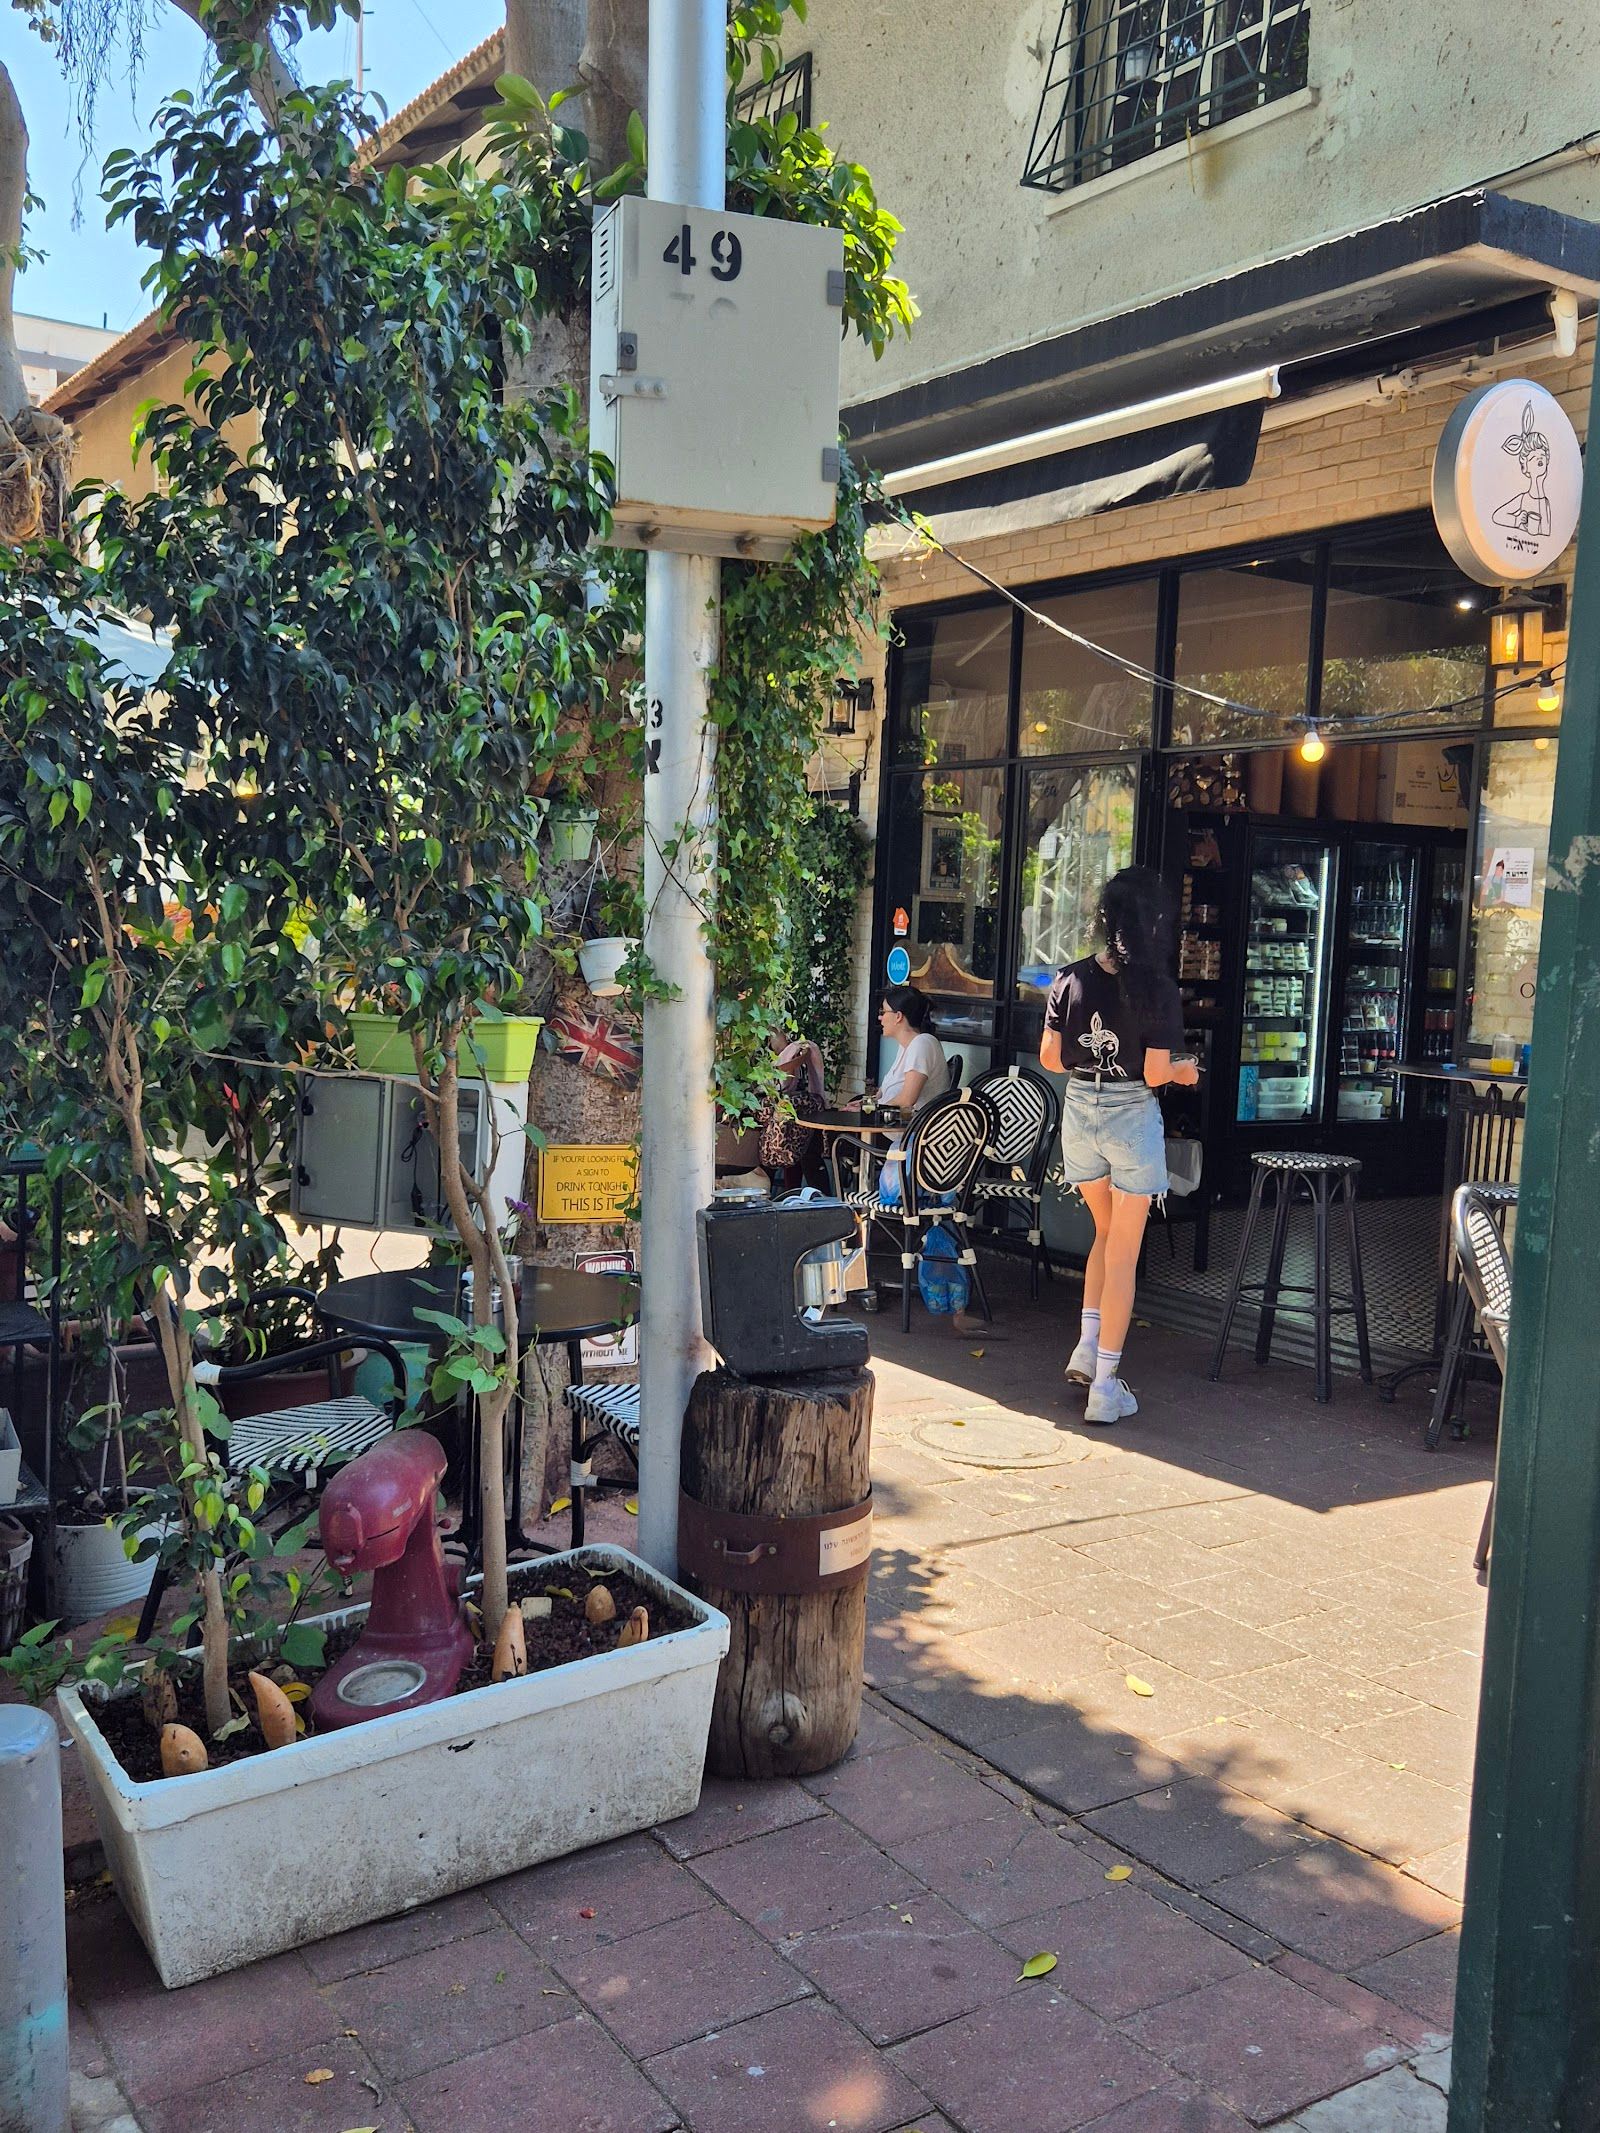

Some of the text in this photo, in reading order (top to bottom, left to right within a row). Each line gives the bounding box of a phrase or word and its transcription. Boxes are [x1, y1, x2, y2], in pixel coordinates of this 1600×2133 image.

[662, 224, 743, 282] 49
[553, 1155, 559, 1163] IF
[560, 1155, 585, 1163] YOU'RE
[587, 1155, 616, 1163] LOOKING
[583, 1168, 599, 1176] SIGN
[600, 1168, 610, 1176] TO
[556, 1181, 586, 1192] DRINK
[561, 1197, 617, 1211] THIS IS IT
[585, 1260, 626, 1273] WARNING
